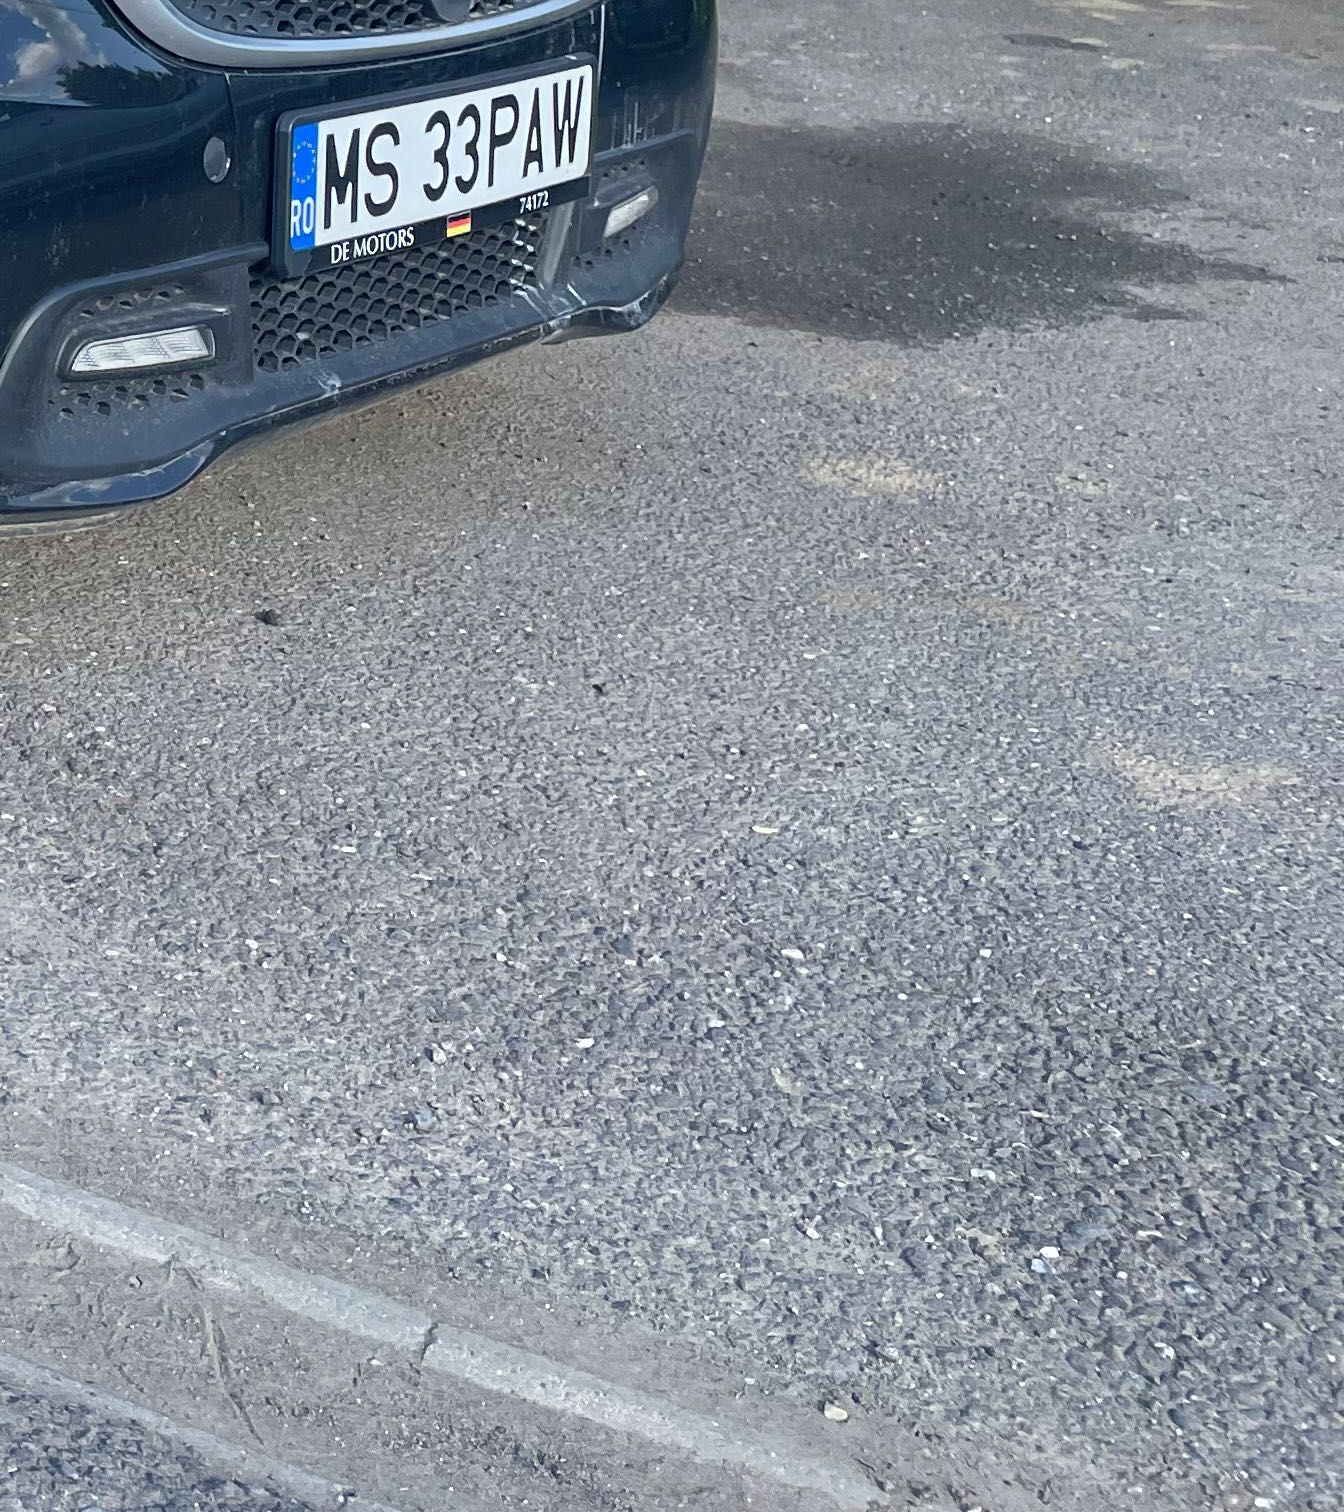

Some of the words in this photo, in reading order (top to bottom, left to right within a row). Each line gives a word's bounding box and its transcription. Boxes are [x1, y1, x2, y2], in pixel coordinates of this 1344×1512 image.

[323, 121, 401, 230] MS
[422, 75, 585, 202] 33PAW
[290, 196, 315, 239] RO
[519, 190, 549, 214] 74172
[330, 240, 350, 265] DE
[352, 226, 415, 259] MOTORS
